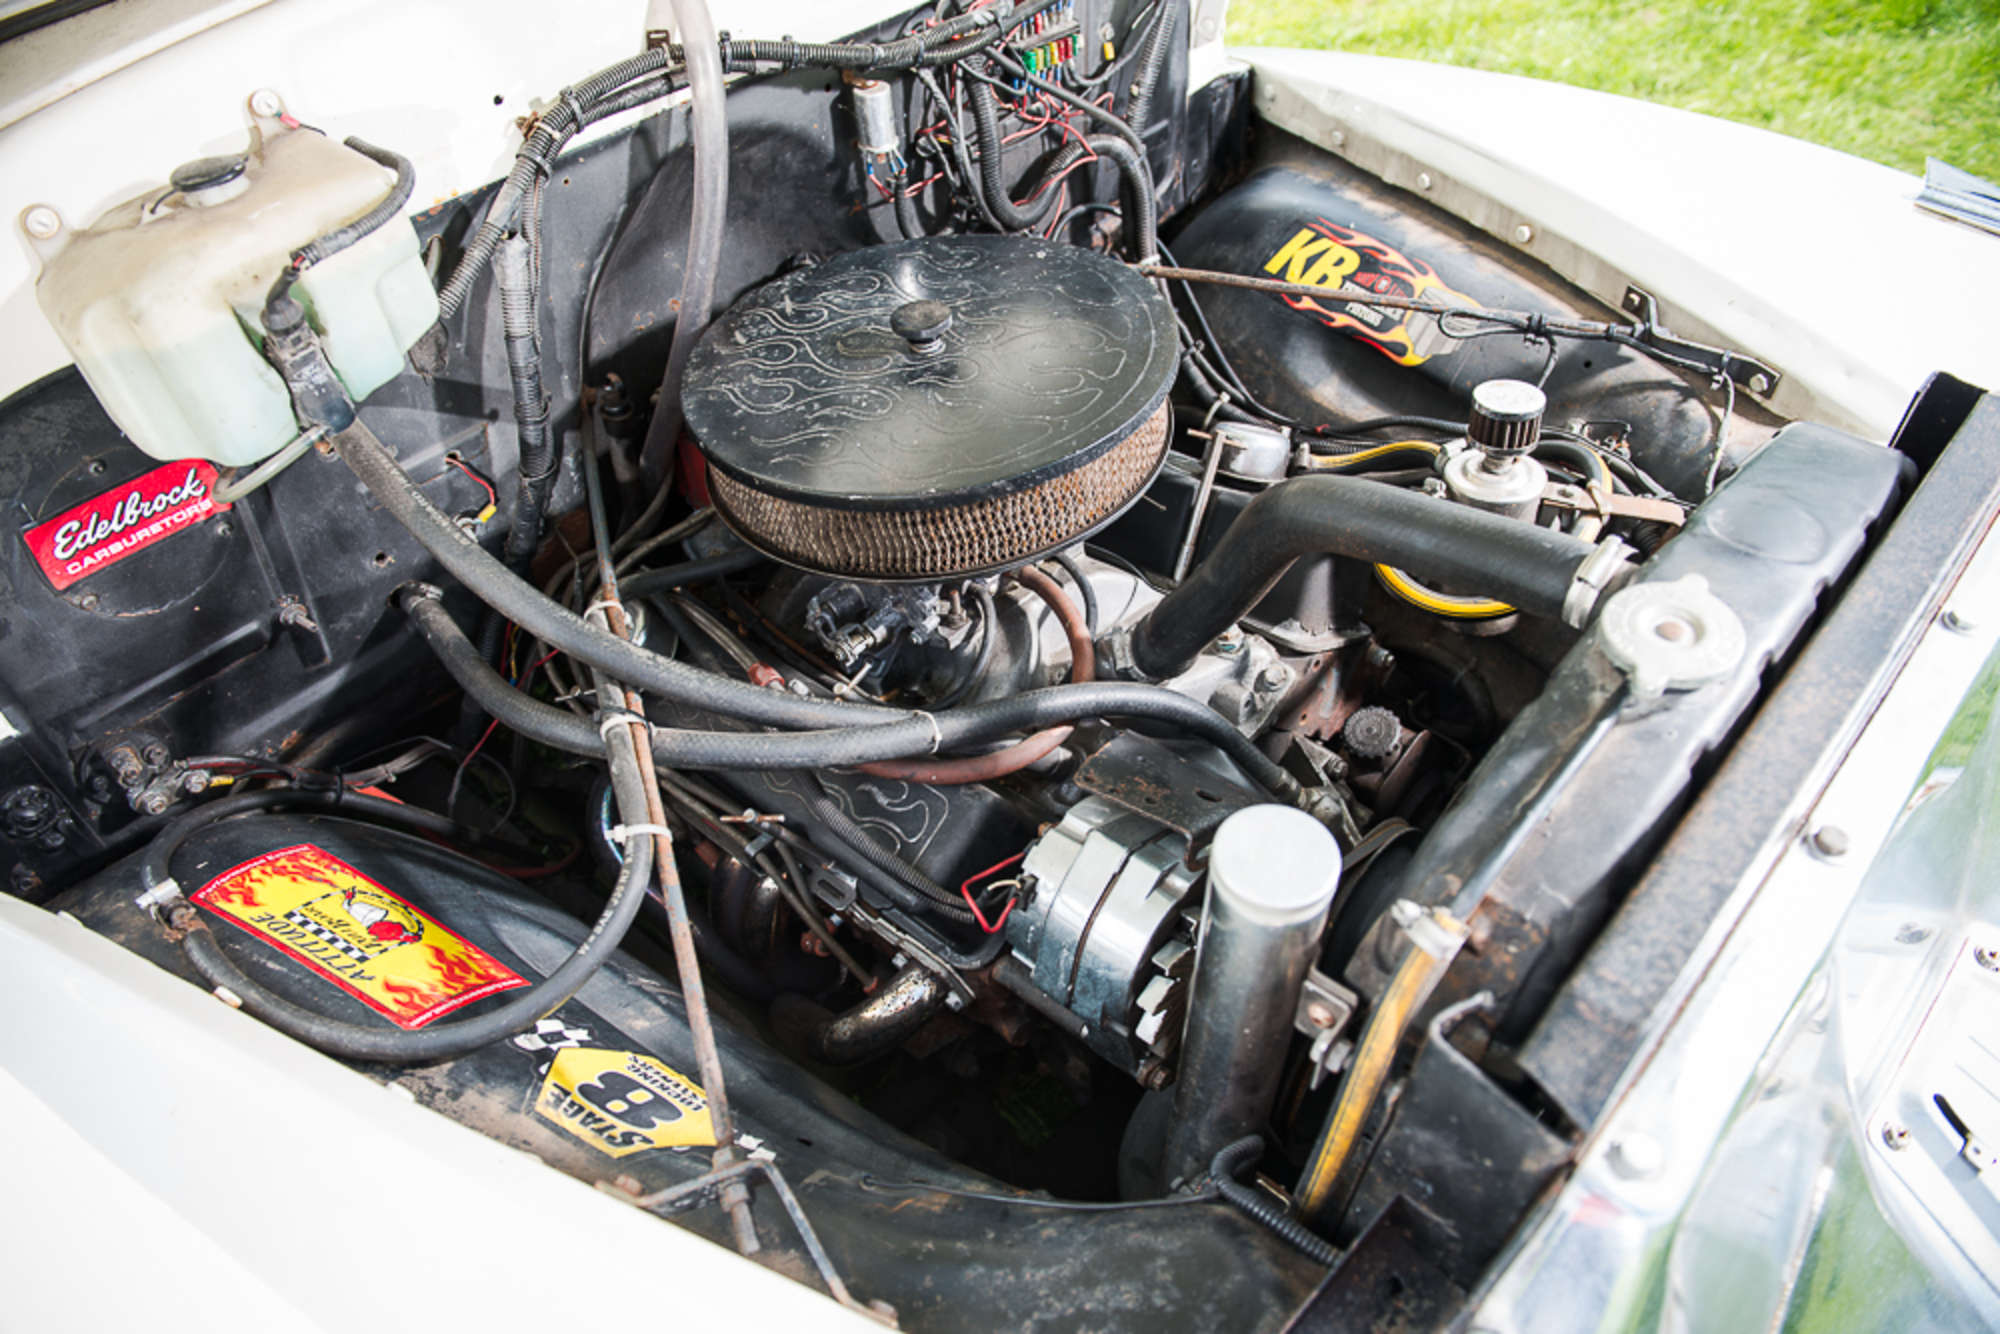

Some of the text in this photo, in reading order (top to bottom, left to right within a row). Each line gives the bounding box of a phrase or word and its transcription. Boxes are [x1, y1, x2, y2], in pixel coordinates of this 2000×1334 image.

[1263, 227, 1361, 290] KB
[54, 467, 206, 561] Edelbrock
[66, 498, 212, 575] CARBURETORS
[250, 911, 376, 981] ATTITUDE
[546, 1081, 655, 1148] STAGE
[576, 1070, 683, 1130] 8
[626, 1063, 703, 1112] LOCKING
